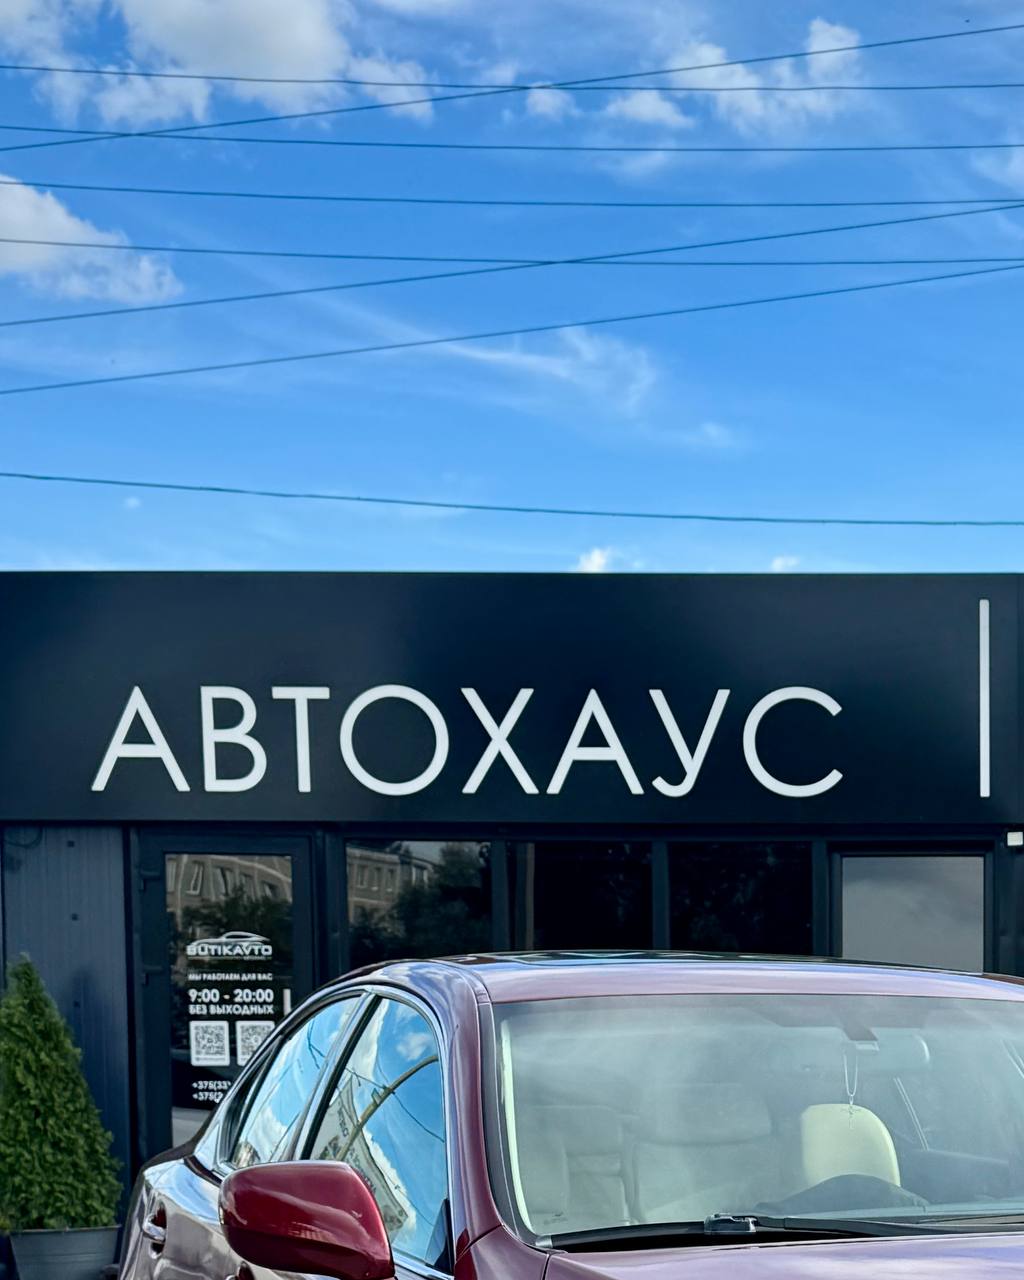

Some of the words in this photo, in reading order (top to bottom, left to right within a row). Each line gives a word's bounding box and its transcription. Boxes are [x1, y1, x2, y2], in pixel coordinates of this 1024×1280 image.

[91, 684, 843, 797] АВТОХАУС
[257, 973, 273, 981] ВАС
[188, 989, 220, 1003] 9:00
[233, 989, 274, 1003] 20:00
[188, 1004, 207, 1015] БЕЗ
[209, 1004, 274, 1015] ВЫХОДНЫХ
